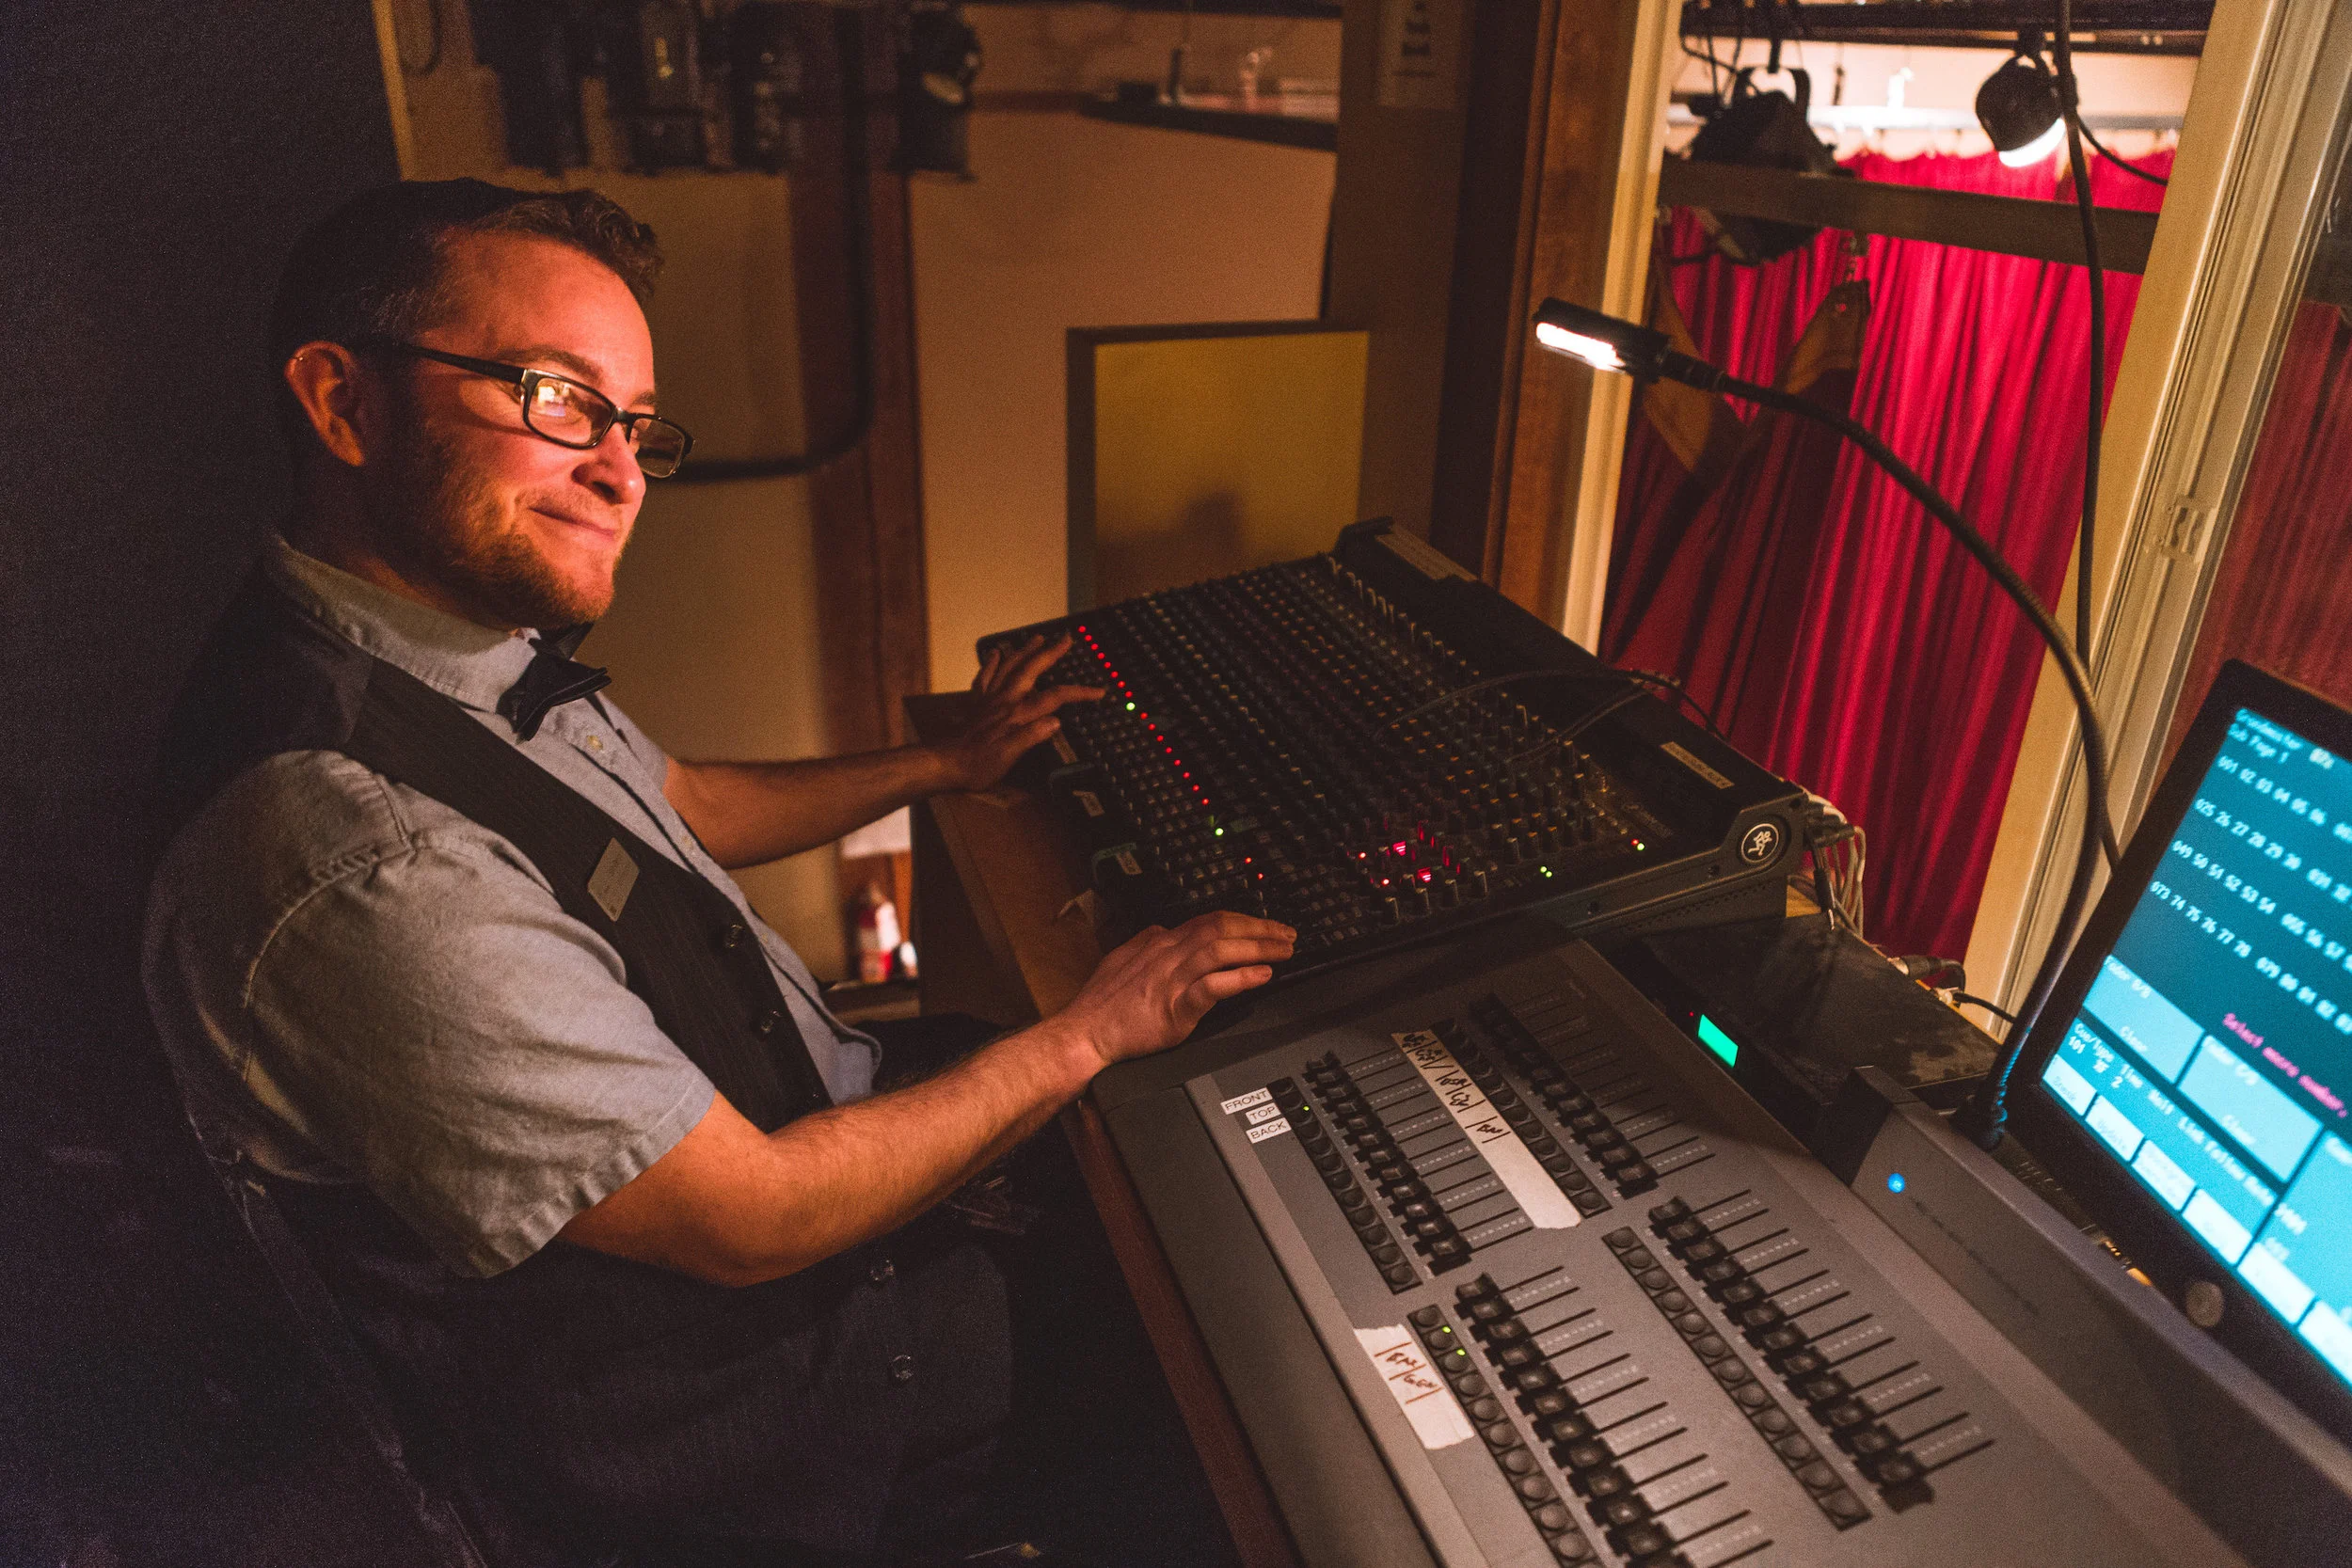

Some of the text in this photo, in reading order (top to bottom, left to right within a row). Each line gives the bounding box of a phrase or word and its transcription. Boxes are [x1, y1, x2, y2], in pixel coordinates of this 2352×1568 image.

[2239, 768, 2256, 784] 02
[2195, 799, 2217, 816] 025
[2215, 811, 2233, 827] 26
[2231, 821, 2250, 836] 27
[2247, 832, 2267, 848] 28
[2192, 853, 2209, 869] 50
[2207, 863, 2225, 879] 51
[2223, 875, 2243, 892] 52
[2239, 885, 2260, 903] 53
[2258, 896, 2277, 914] 54
[2150, 881, 2253, 958] 073 74 75 76 77 78
[2068, 1036, 2086, 1054] 101
[2111, 1076, 2123, 1088] 2
[2074, 1023, 2115, 1063] Cue/Type
[1225, 1091, 1267, 1111] FRONT
[1249, 1106, 1275, 1119] TOP
[1250, 1121, 1287, 1139] BACK
